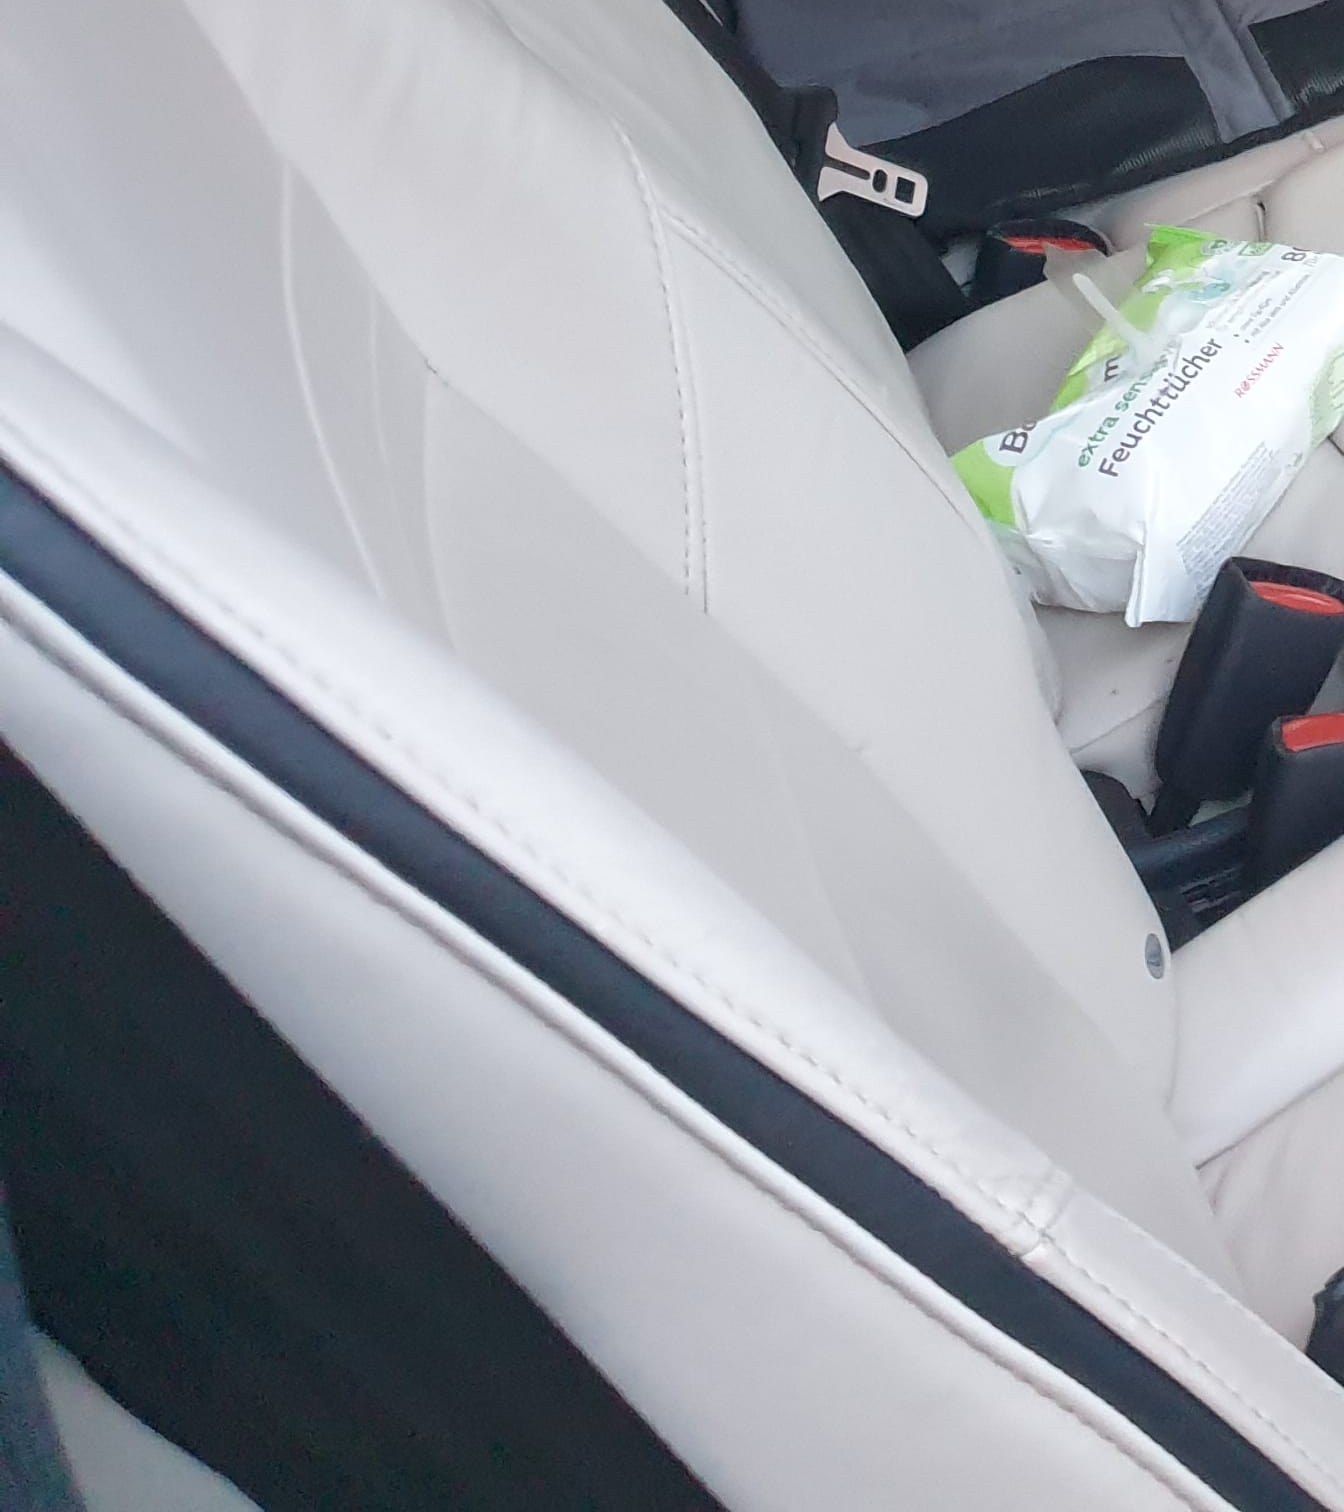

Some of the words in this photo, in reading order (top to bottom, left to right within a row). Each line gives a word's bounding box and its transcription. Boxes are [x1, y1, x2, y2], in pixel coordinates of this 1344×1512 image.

[1234, 342, 1285, 399] ROSSMANN
[1097, 337, 1223, 478] Feuchttücher
[1077, 415, 1120, 468] extra
